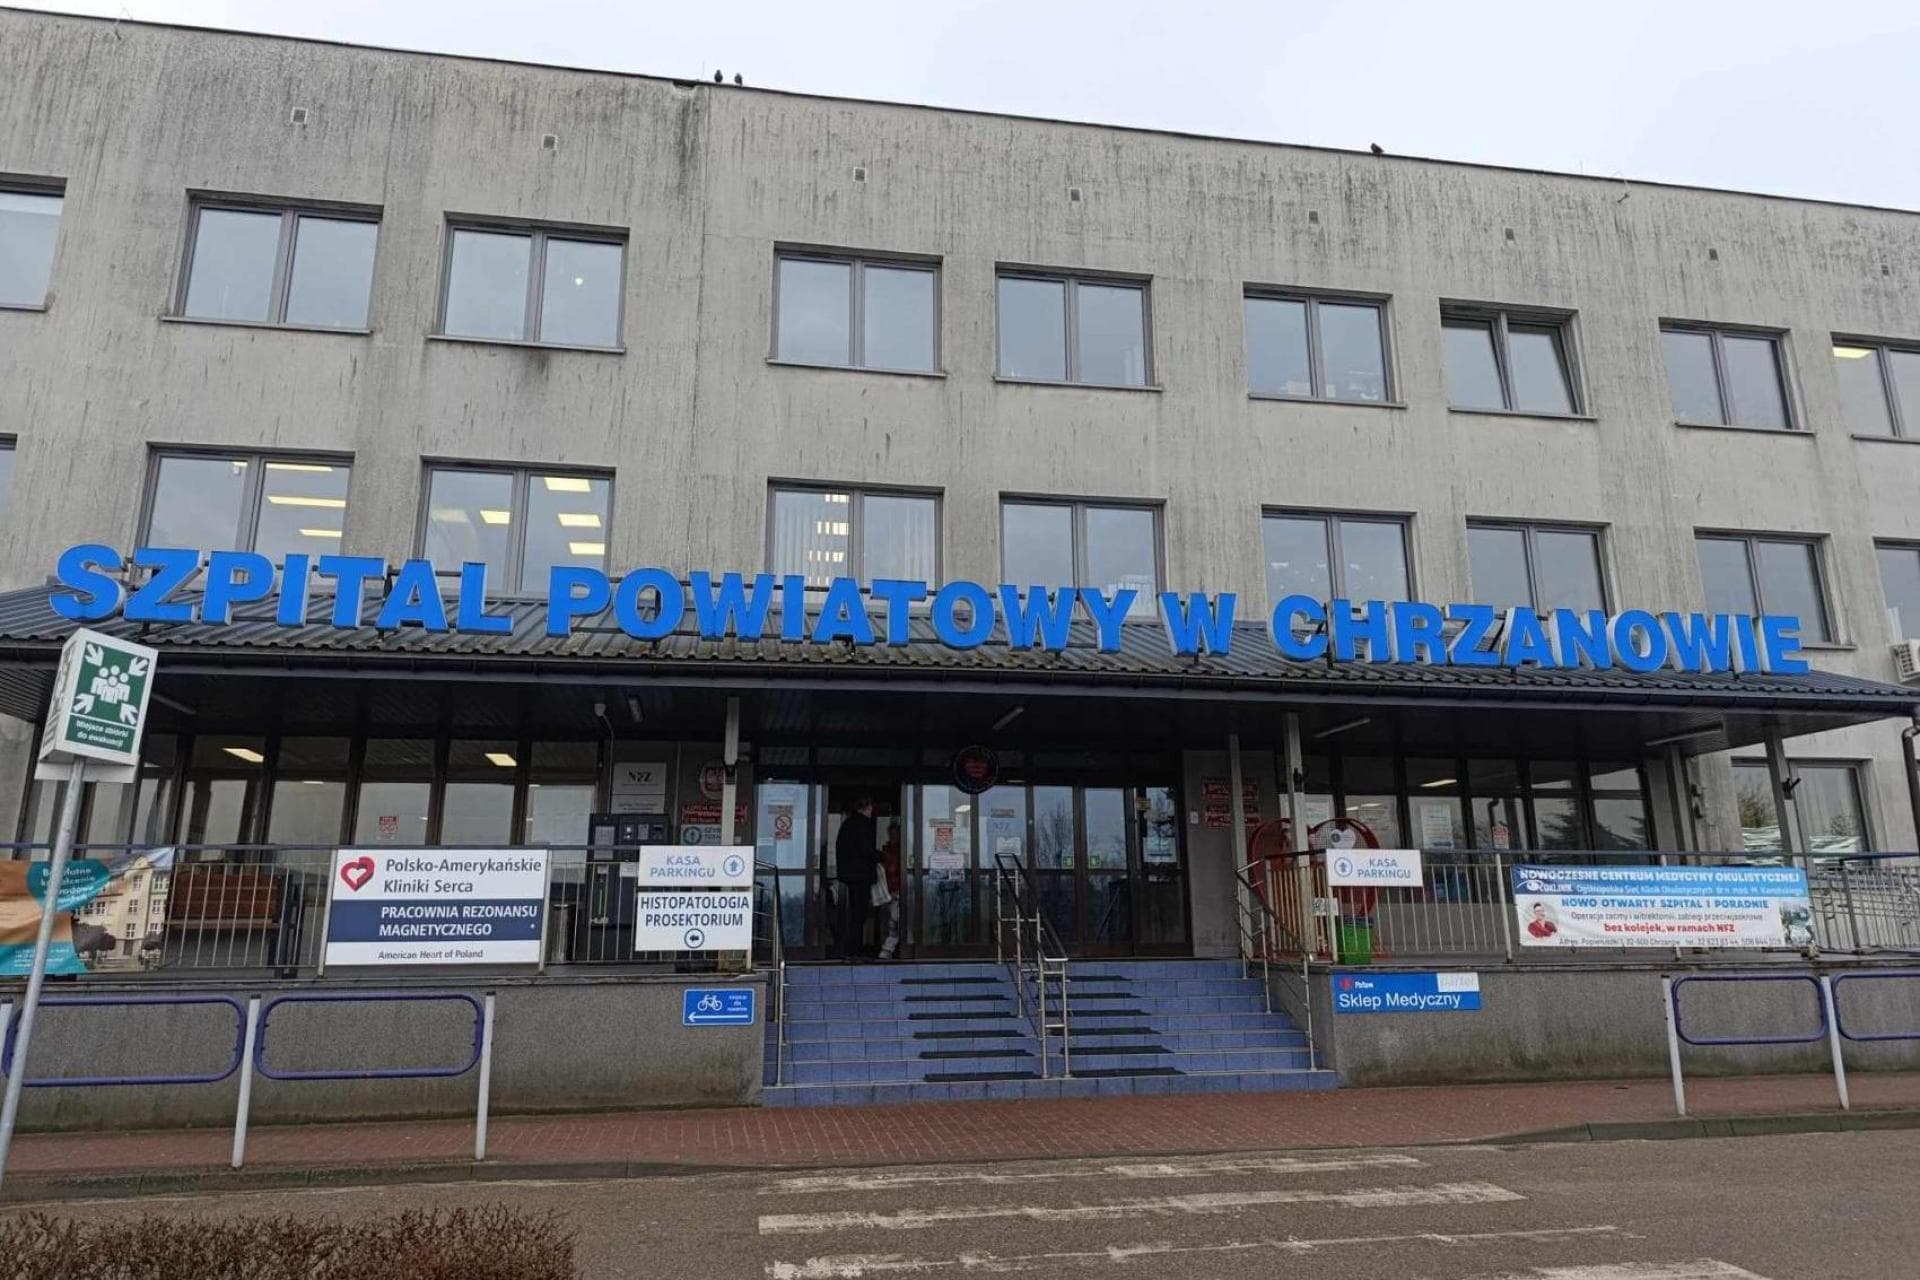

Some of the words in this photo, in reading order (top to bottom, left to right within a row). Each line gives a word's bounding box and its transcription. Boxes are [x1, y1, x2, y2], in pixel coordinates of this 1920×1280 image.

[49, 544, 512, 634] SZPITAL
[547, 564, 1138, 654] POWIATOWY
[1159, 592, 1236, 656] W
[1268, 594, 1809, 677] CHRZANOWIE
[385, 857, 542, 876] Polsko-Amerykańskie
[666, 855, 701, 866] KASA
[1369, 857, 1398, 867] KASA
[650, 867, 716, 878] PARKINGU
[1357, 868, 1412, 879] PARKINGU
[1520, 870, 1599, 881] NOWOCZESNE
[1600, 870, 1654, 881] CENTRUM
[1656, 871, 1713, 882] MEDYCYNY
[1715, 871, 1799, 882] OKULISTYCZNEJ
[383, 879, 429, 893] Kliniki
[434, 879, 474, 893] Serca
[640, 896, 750, 910] HISTOPATOLOGIA
[1561, 898, 1598, 908] NOWO
[1601, 899, 1656, 909] OTWARTY
[1660, 899, 1703, 909] SZPITAL
[1715, 900, 1769, 909] PORADNIE
[381, 905, 459, 919] PRACOWNIA
[462, 904, 538, 918] REZONANSU
[645, 913, 743, 927] PROSEKTORIUM
[379, 923, 492, 937] MAGNETYCZNEGO
[1604, 923, 1622, 932] bez
[1624, 923, 1666, 934] kolejek,
[1677, 923, 1716, 933] ramach
[1716, 923, 1736, 933] NFZ
[378, 951, 417, 960] American
[419, 950, 442, 959] Heart
[444, 950, 453, 959] of
[455, 949, 483, 959] Poland
[1339, 993, 1381, 1010] Sklep
[1386, 992, 1461, 1010] Medyczny
